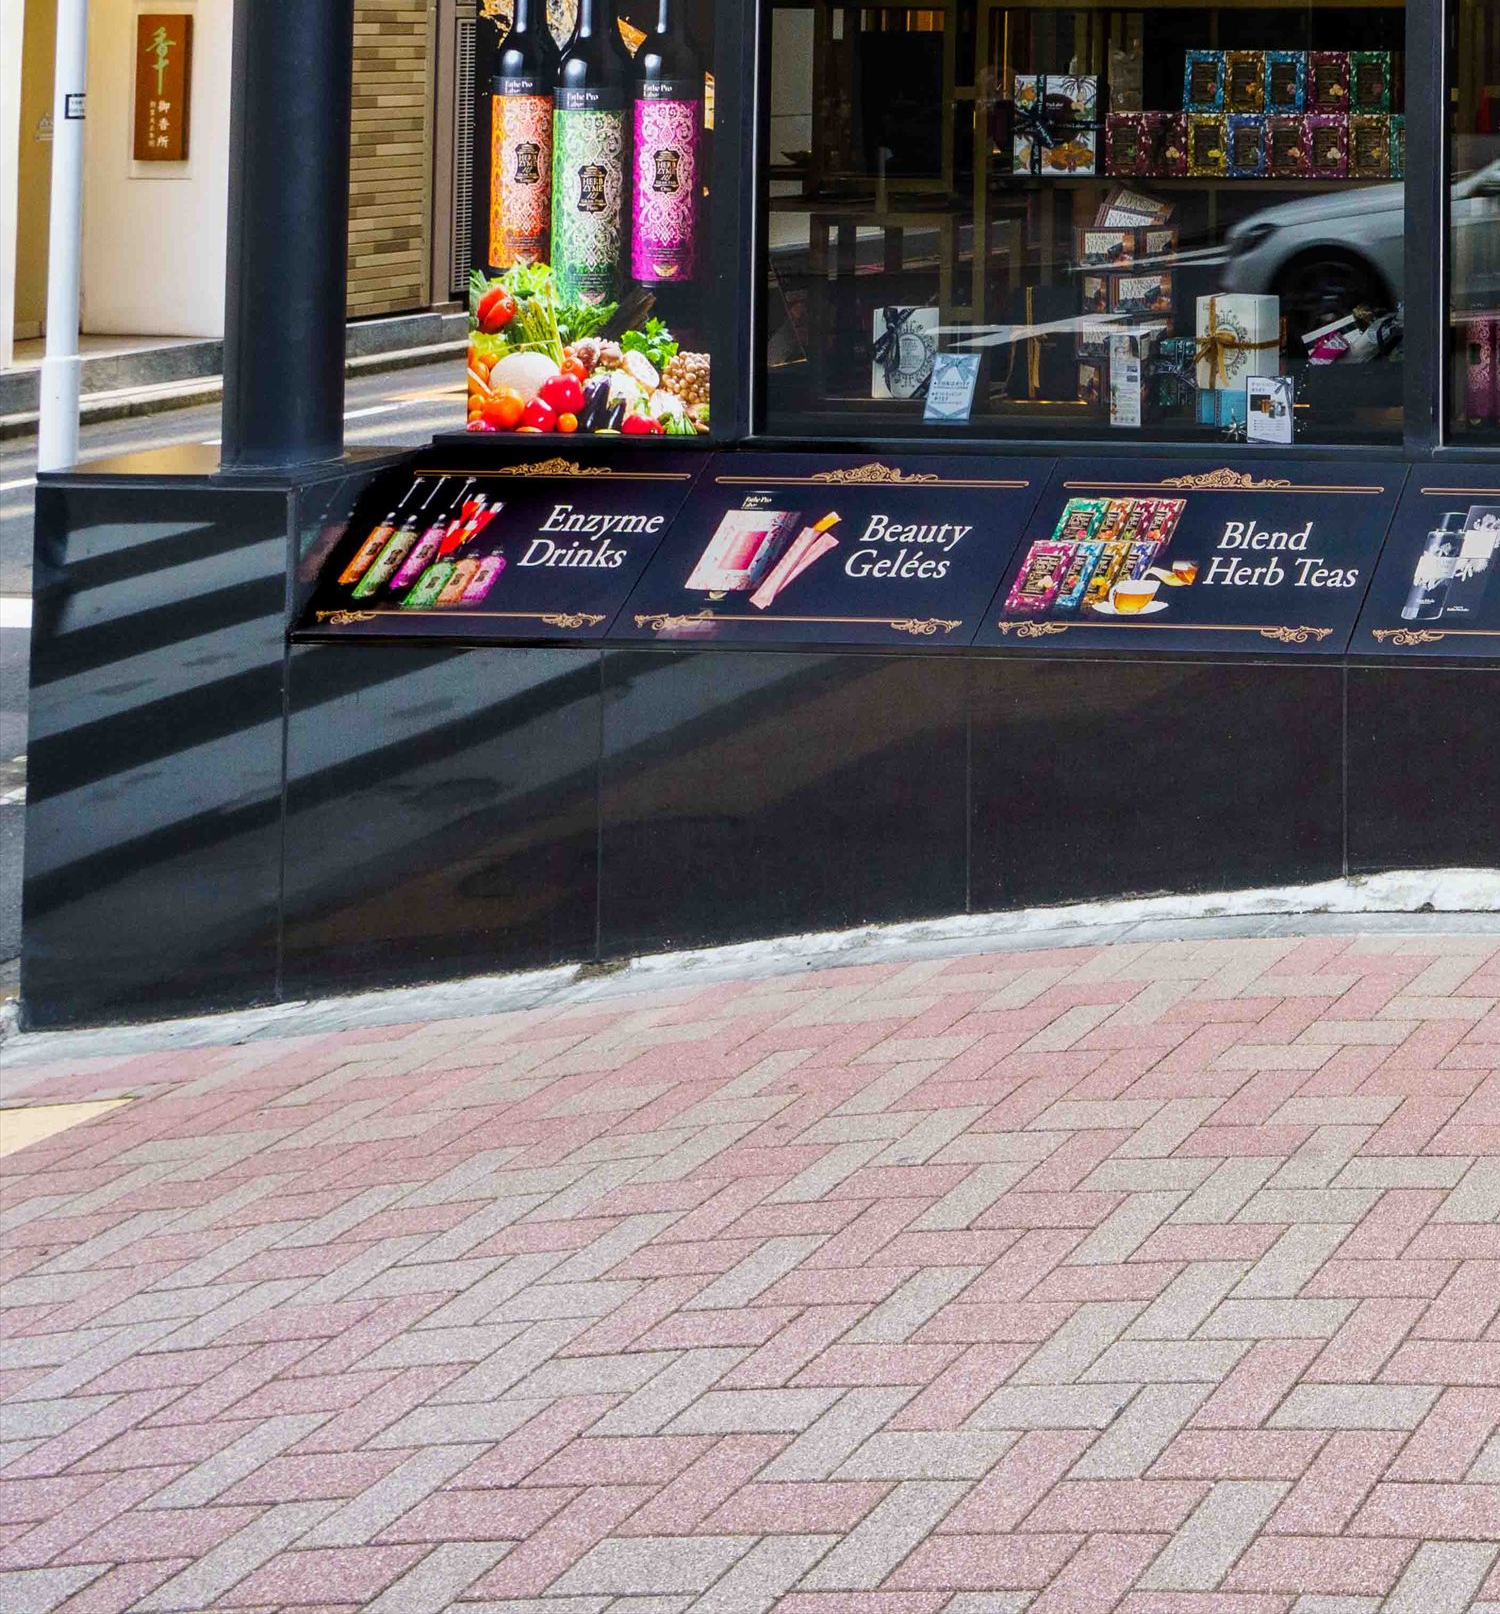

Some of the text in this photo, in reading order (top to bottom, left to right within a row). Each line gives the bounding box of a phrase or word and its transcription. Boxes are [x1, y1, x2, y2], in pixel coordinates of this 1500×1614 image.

[539, 504, 665, 538] Enzyme
[859, 514, 973, 551] Beauty
[1217, 521, 1316, 552] Blend
[517, 538, 628, 570] Drinks
[843, 547, 951, 580] Gelées
[1201, 556, 1360, 589] Herb Teas
